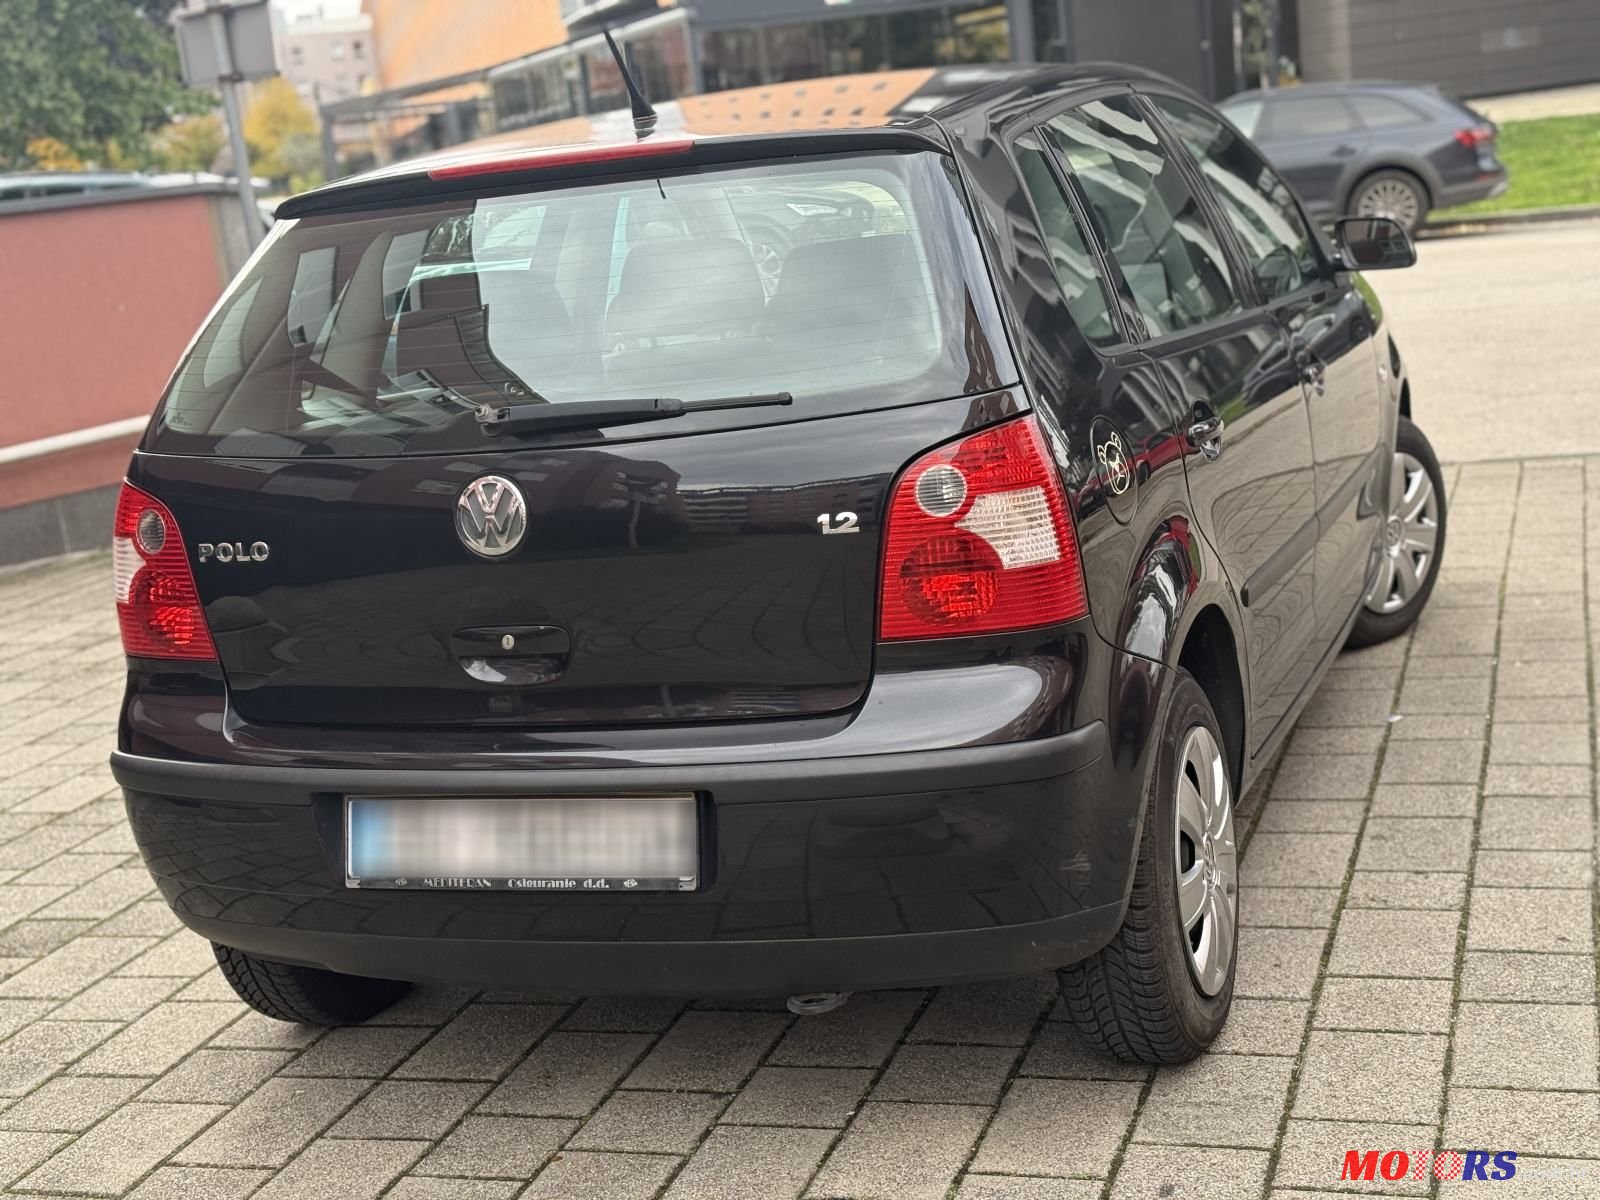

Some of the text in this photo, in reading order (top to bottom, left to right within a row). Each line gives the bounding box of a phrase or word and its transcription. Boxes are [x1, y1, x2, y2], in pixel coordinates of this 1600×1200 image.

[198, 541, 270, 562] POLO
[422, 877, 492, 888] MEDITERAN
[582, 878, 610, 888] d.d.
